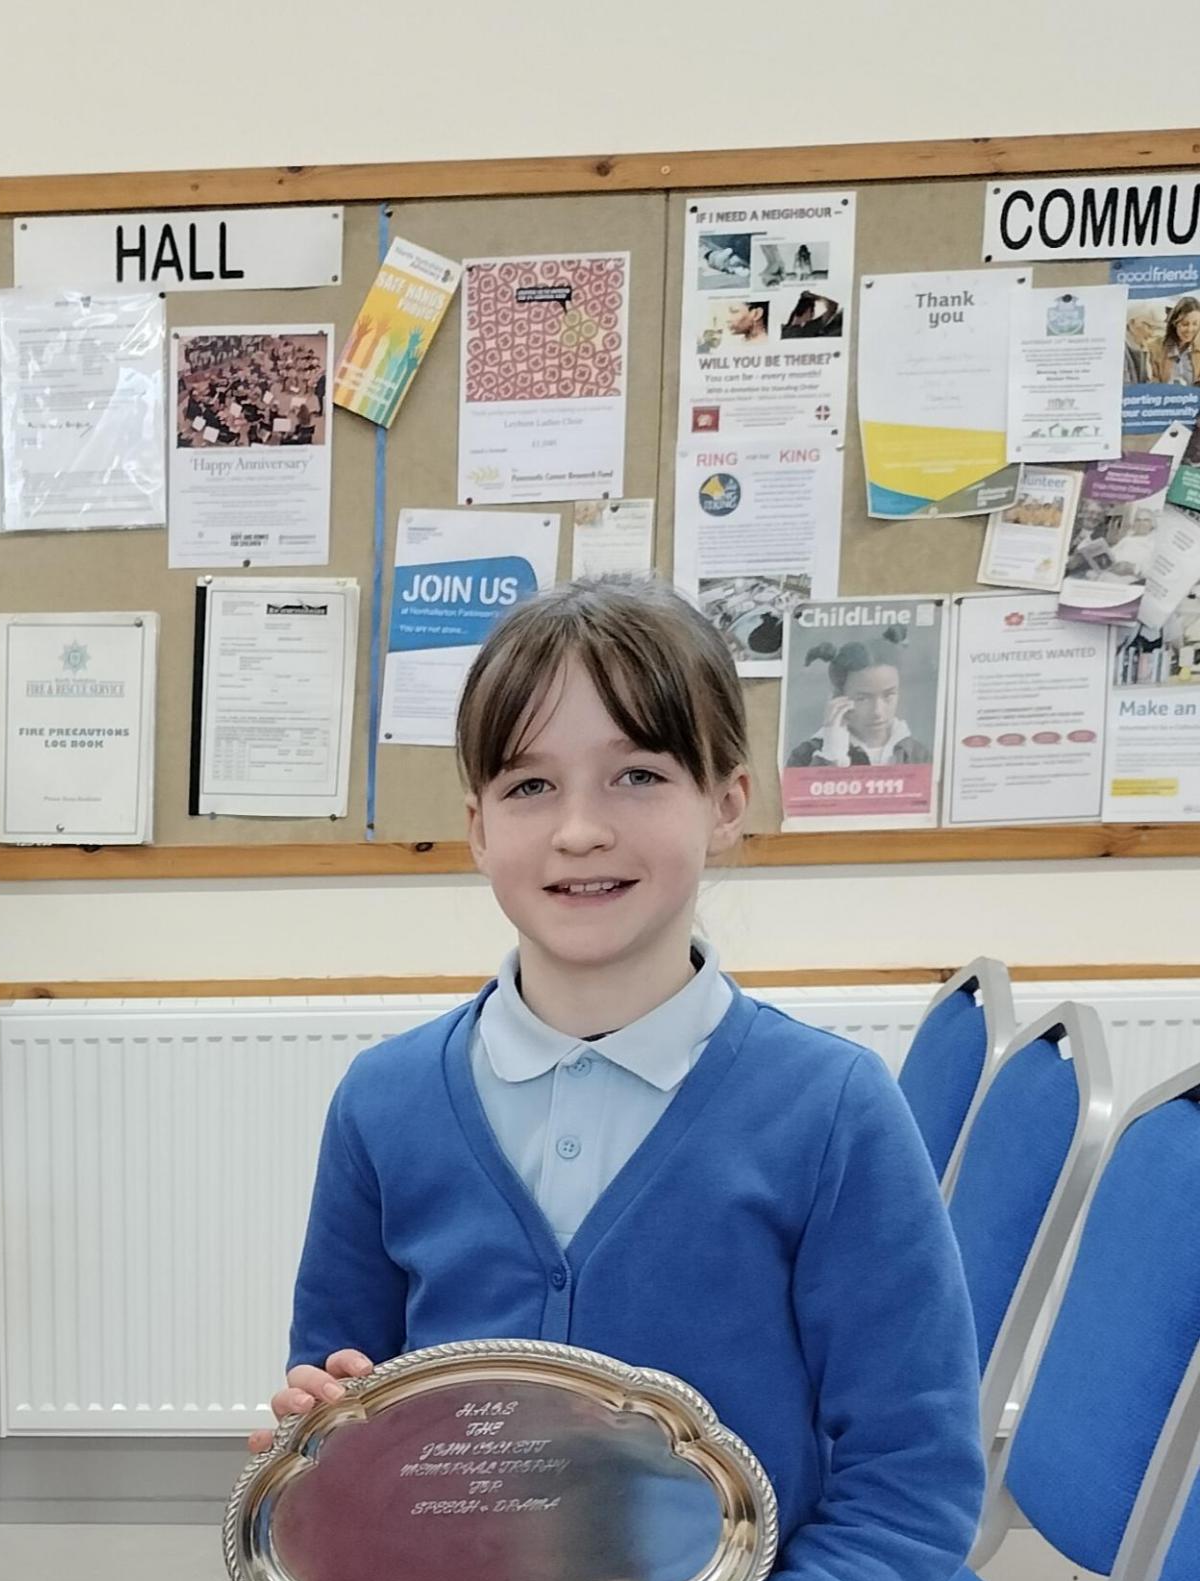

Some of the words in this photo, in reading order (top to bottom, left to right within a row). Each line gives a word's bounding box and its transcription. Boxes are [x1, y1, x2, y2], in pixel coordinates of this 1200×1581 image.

[696, 212, 707, 224] IF
[715, 211, 747, 222] NEED
[750, 210, 759, 221] A
[761, 207, 832, 220] NEIGHBOUR
[1001, 183, 1200, 250] COMMU
[116, 221, 244, 282] HALL
[1117, 263, 1199, 283] goodfriends
[915, 290, 975, 309] Thank
[929, 311, 964, 329] you
[699, 357, 730, 370] WILL
[732, 355, 761, 368] YOU
[765, 355, 781, 367] BE
[783, 352, 832, 366] THERE?
[704, 374, 721, 383] You
[724, 374, 739, 383] can
[742, 372, 753, 381] be
[761, 371, 786, 382] every
[1123, 394, 1162, 407] porting
[696, 452, 738, 467] RING
[779, 449, 821, 463] KING
[1022, 475, 1067, 489] lunteer
[402, 574, 472, 604] JOIN
[480, 576, 518, 605] US
[799, 605, 911, 627] ChildLine
[969, 650, 1043, 664] VOLUNTEERS
[1045, 647, 1096, 660] WANTED
[26, 684, 47, 695] FIRE
[56, 683, 88, 695] RESCUE
[89, 684, 125, 695] SERVICE
[1119, 700, 1169, 717] Make
[1174, 703, 1197, 716] an
[18, 728, 45, 736] FIRE
[49, 728, 130, 736] PRECAUTIONS
[44, 740, 67, 748] LOG
[70, 740, 104, 748] BOOK
[810, 781, 861, 796] 0800
[865, 779, 904, 794] 1111
[466, 1421, 504, 1436] THE
[419, 1442, 471, 1460] JOHN
[400, 1462, 497, 1477] MEMORIAL
[498, 1458, 571, 1475] TROPHY
[468, 1480, 503, 1494] FOR
[411, 1500, 480, 1515] SPEECH
[493, 1496, 561, 1513] DRAMA
